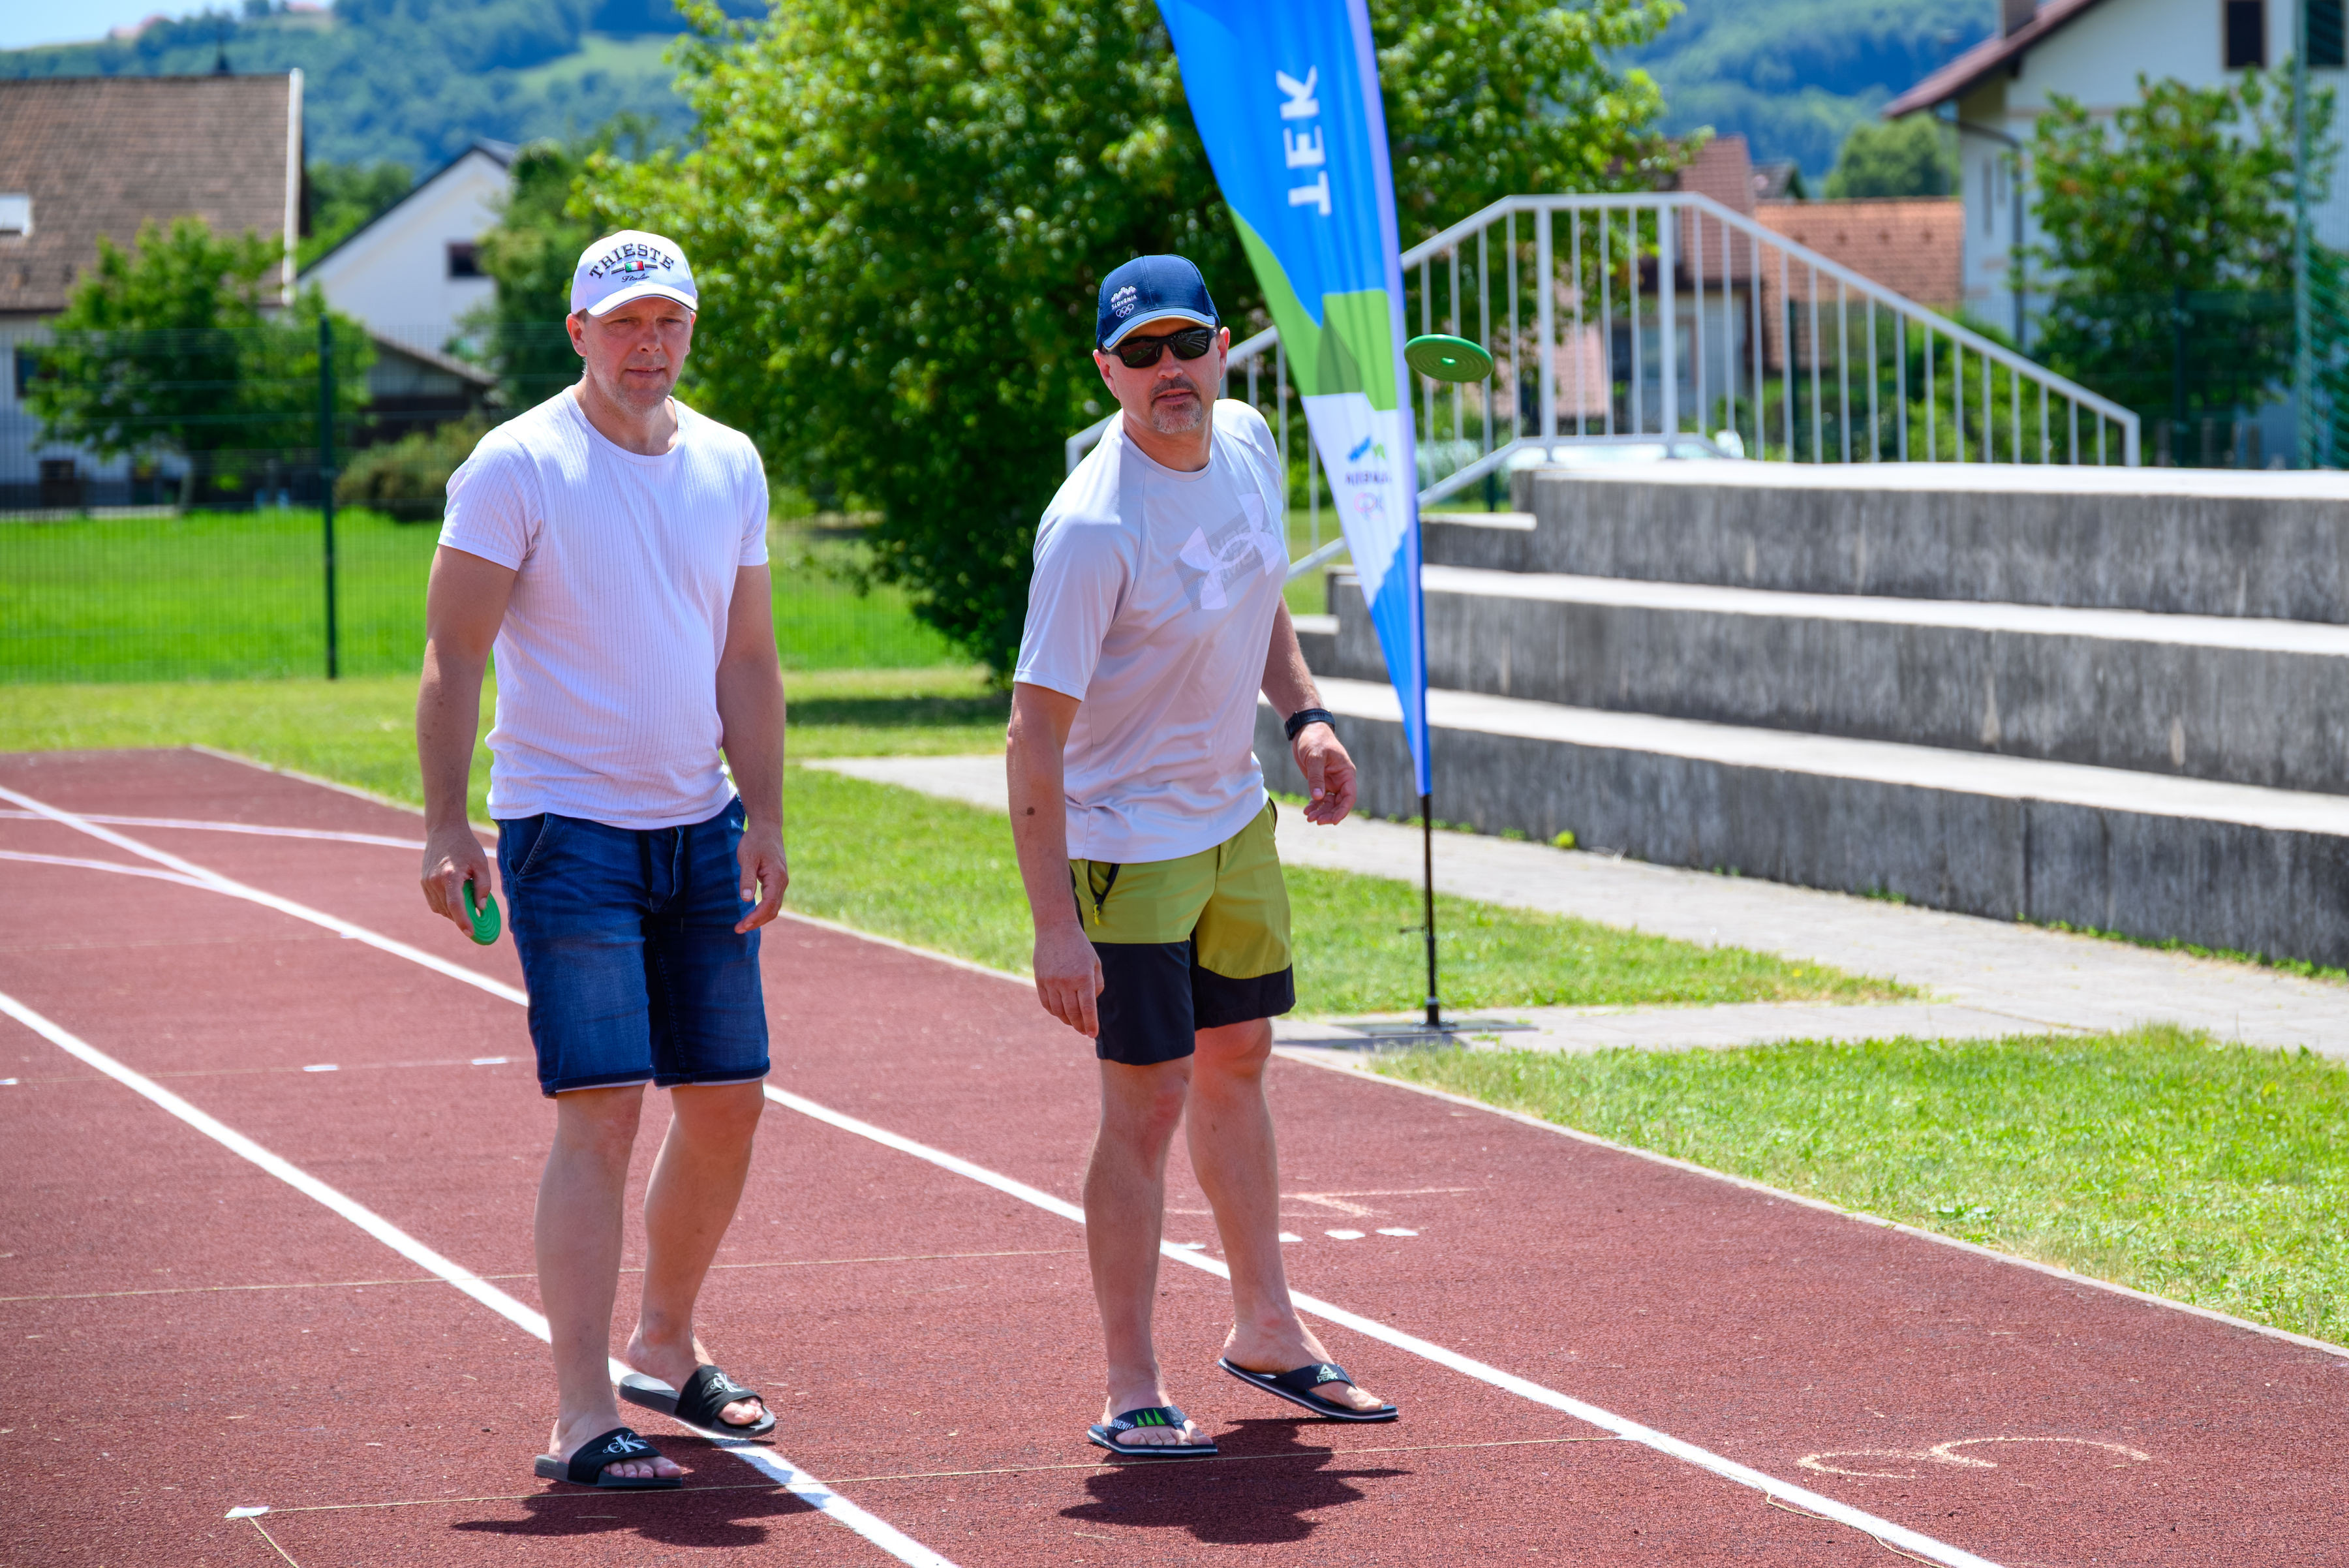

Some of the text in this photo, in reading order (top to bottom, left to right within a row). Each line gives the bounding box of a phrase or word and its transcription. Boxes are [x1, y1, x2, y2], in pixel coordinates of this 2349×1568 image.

[589, 243, 674, 279] TRIESTE
[1111, 294, 1137, 310] SLOVENIA
[1316, 1372, 1338, 1383] PEAK
